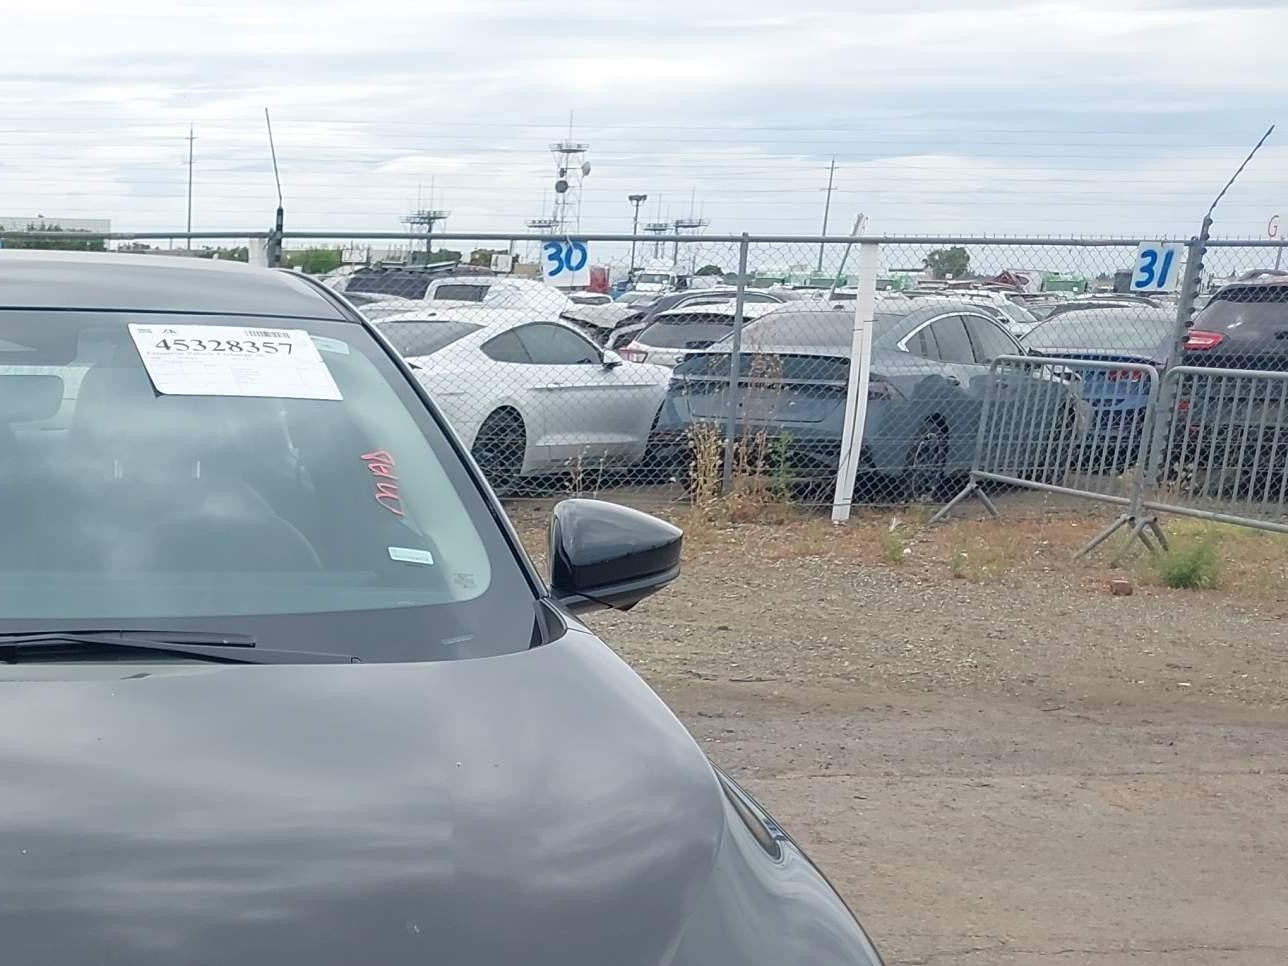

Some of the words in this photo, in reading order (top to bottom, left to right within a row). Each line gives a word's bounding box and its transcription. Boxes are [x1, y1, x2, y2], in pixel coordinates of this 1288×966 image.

[543, 240, 588, 277] 30
[1134, 249, 1174, 289] 31
[155, 338, 293, 355] 45328357
